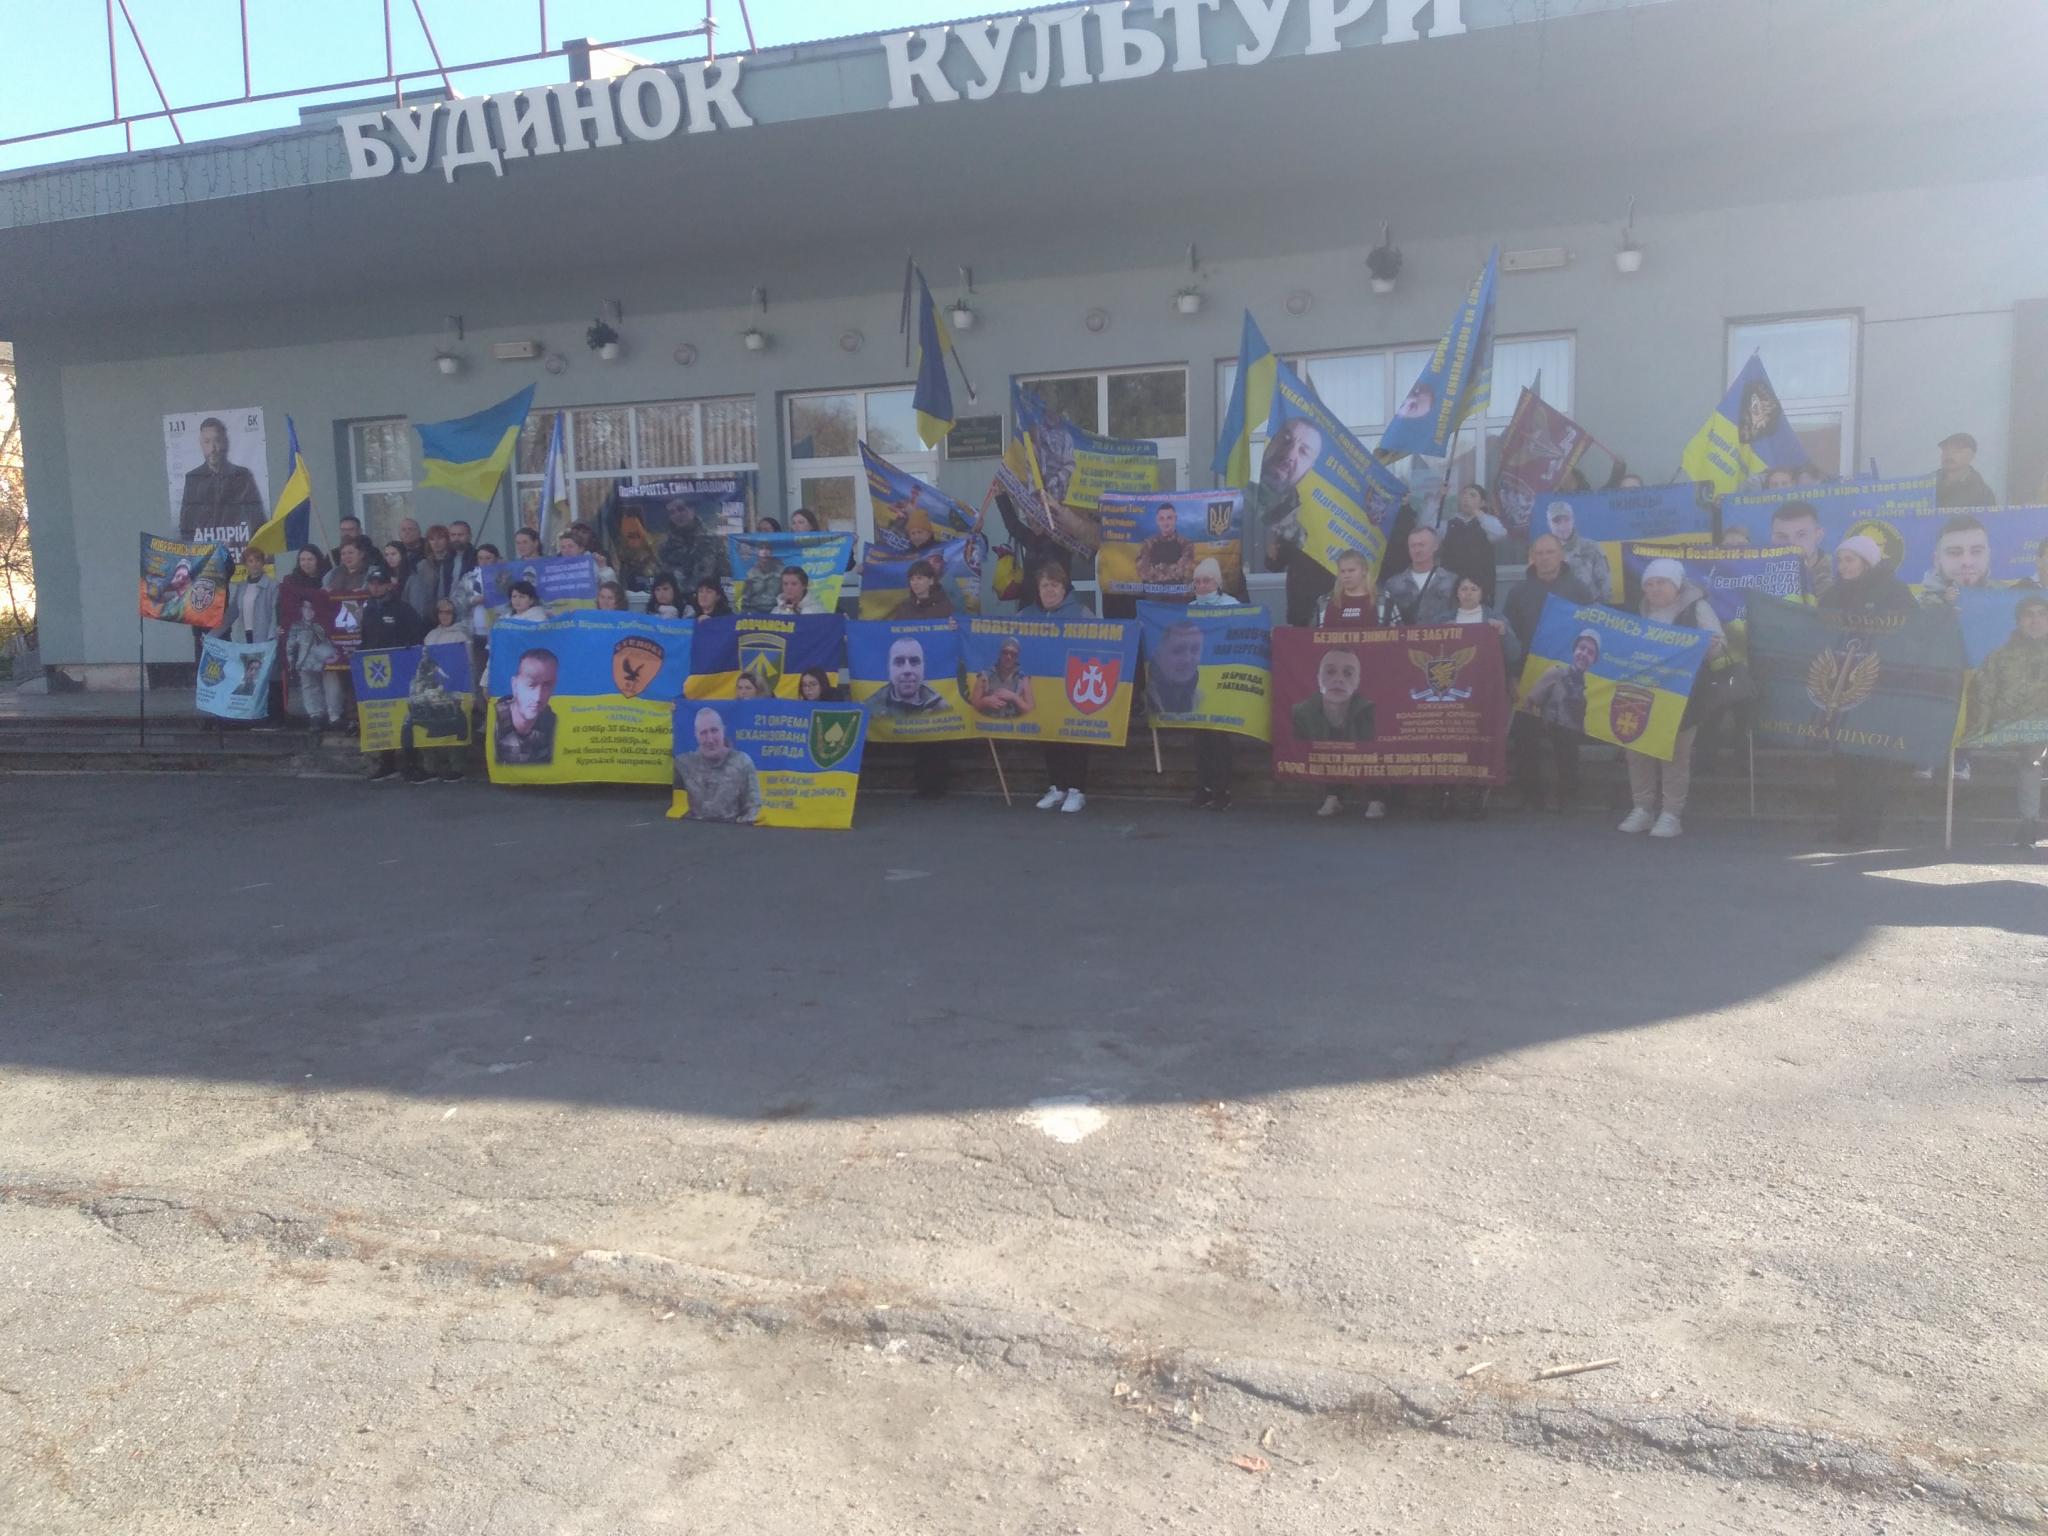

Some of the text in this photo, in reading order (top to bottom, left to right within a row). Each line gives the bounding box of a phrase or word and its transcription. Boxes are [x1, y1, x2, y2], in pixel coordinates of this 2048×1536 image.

[337, 0, 1468, 183] БУДИНОК КУЛЬТУРИ
[669, 481, 694, 496] СИНА
[194, 521, 249, 542] АНДРІЙ
[1714, 575, 1753, 589] Сергій
[971, 619, 1124, 641] ПОВЕРНИСЬ ЖИВИМ
[1313, 630, 1360, 644] БЕЗВІСТИ
[1361, 629, 1399, 643] ЗНИКЛІ
[1407, 629, 1422, 641] НЕ
[1642, 625, 1701, 648] ЖИВИМ
[753, 714, 809, 729] 21 ОКРЕМА
[1837, 727, 1906, 751] ПІХОТА
[760, 745, 805, 759] БРИГАДА
[1364, 765, 1385, 777] ТЕБЕ
